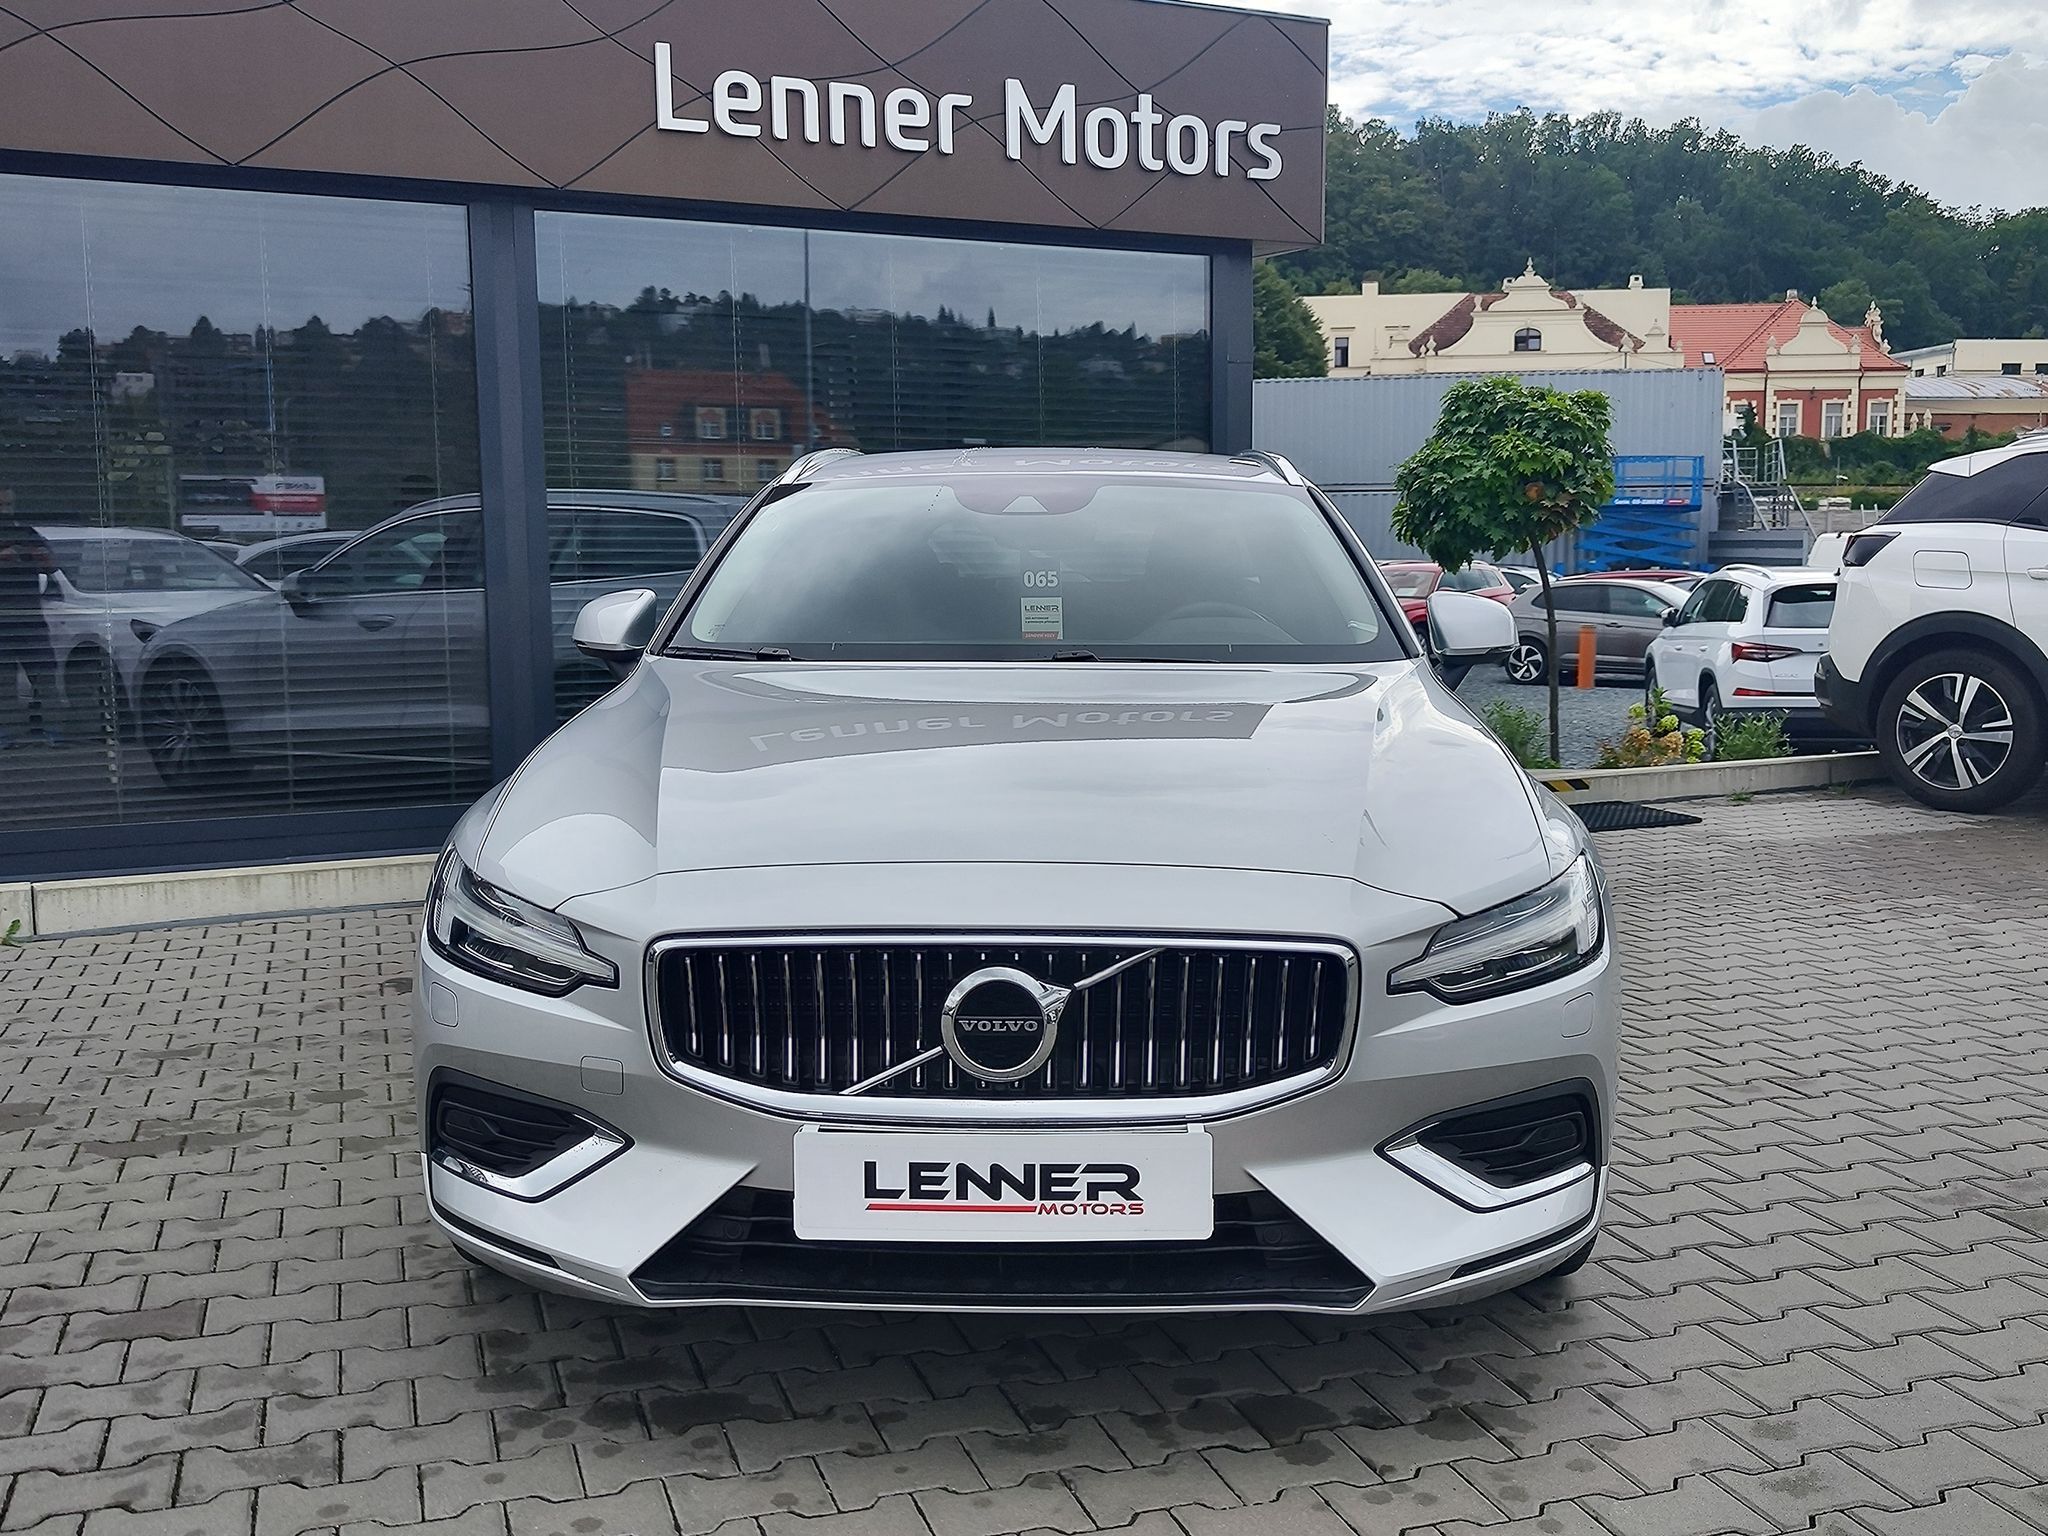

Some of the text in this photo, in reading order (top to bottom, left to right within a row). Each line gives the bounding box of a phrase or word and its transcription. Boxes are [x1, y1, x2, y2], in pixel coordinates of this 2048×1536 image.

[654, 41, 1283, 181] Lenner Motors
[1023, 570, 1059, 588] 065
[1024, 604, 1059, 613] LENNER
[958, 1020, 1038, 1032] VOLVO
[863, 1161, 1145, 1201] LENNER
[1037, 1203, 1145, 1216] MOTORS
